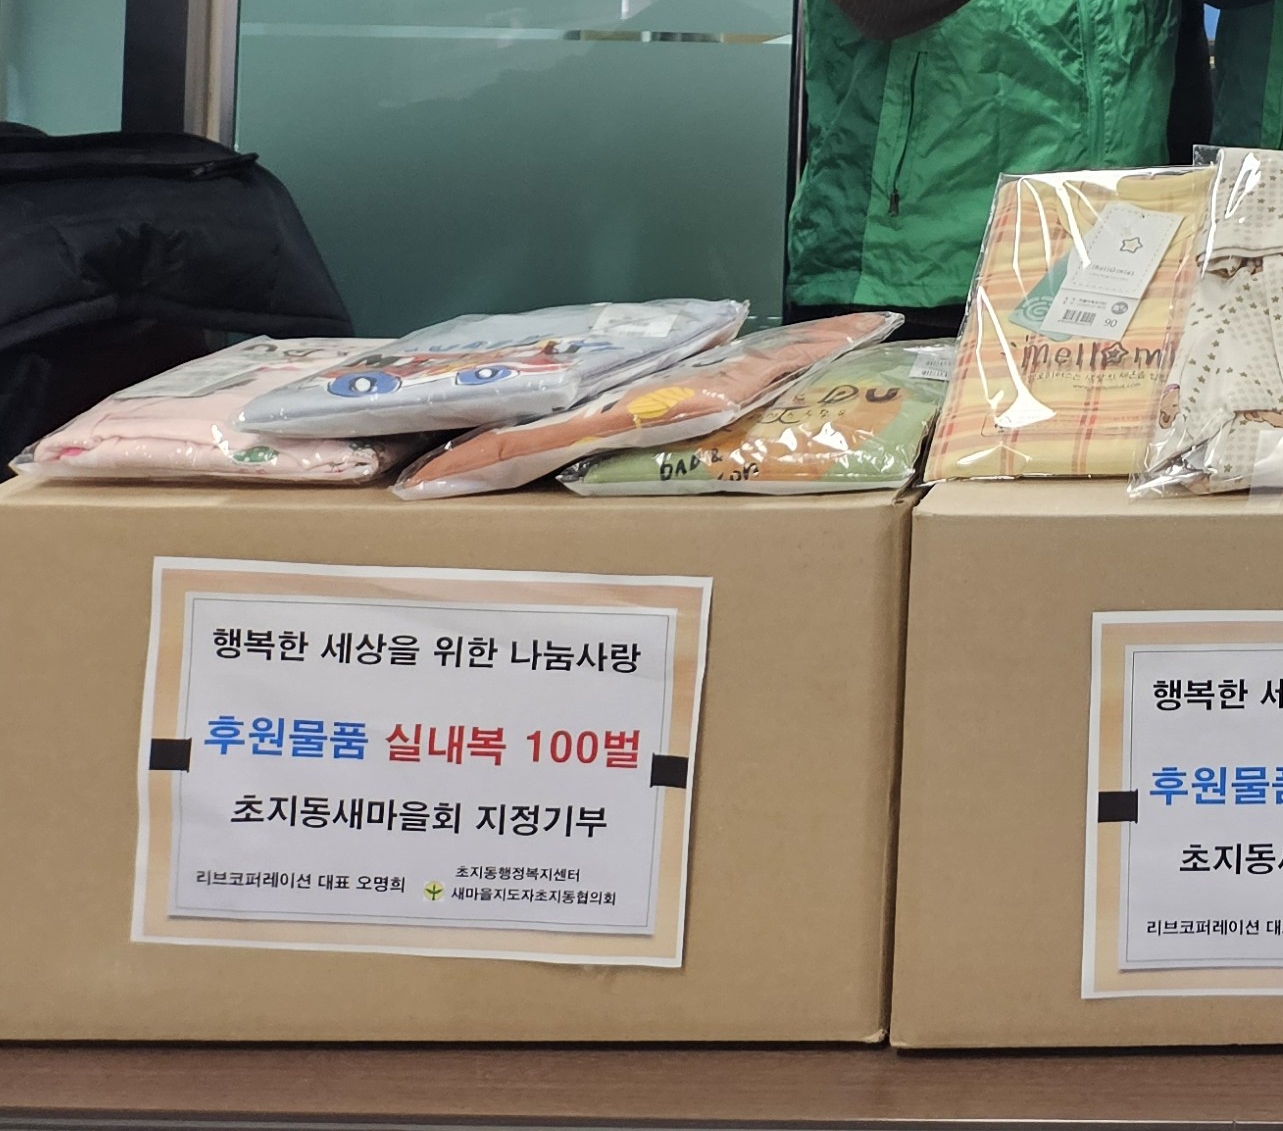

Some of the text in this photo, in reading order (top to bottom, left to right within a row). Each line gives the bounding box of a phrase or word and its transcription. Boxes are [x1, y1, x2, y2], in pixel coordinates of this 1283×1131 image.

[213, 629, 641, 673] 행복한 세상을 위한 나눔사랑
[1154, 679, 1248, 710] 행복한
[205, 716, 639, 768] 후원물품 실내복 100벌
[231, 795, 606, 837] 초지동새마을회 지정기부
[197, 871, 404, 892] 리브코퍼레이션 대표 오명희
[456, 866, 579, 882] 초지동행정복지센터
[452, 887, 615, 905] 새마을지도자초지동협의회
[1148, 920, 1259, 935] 리브코퍼레이션
